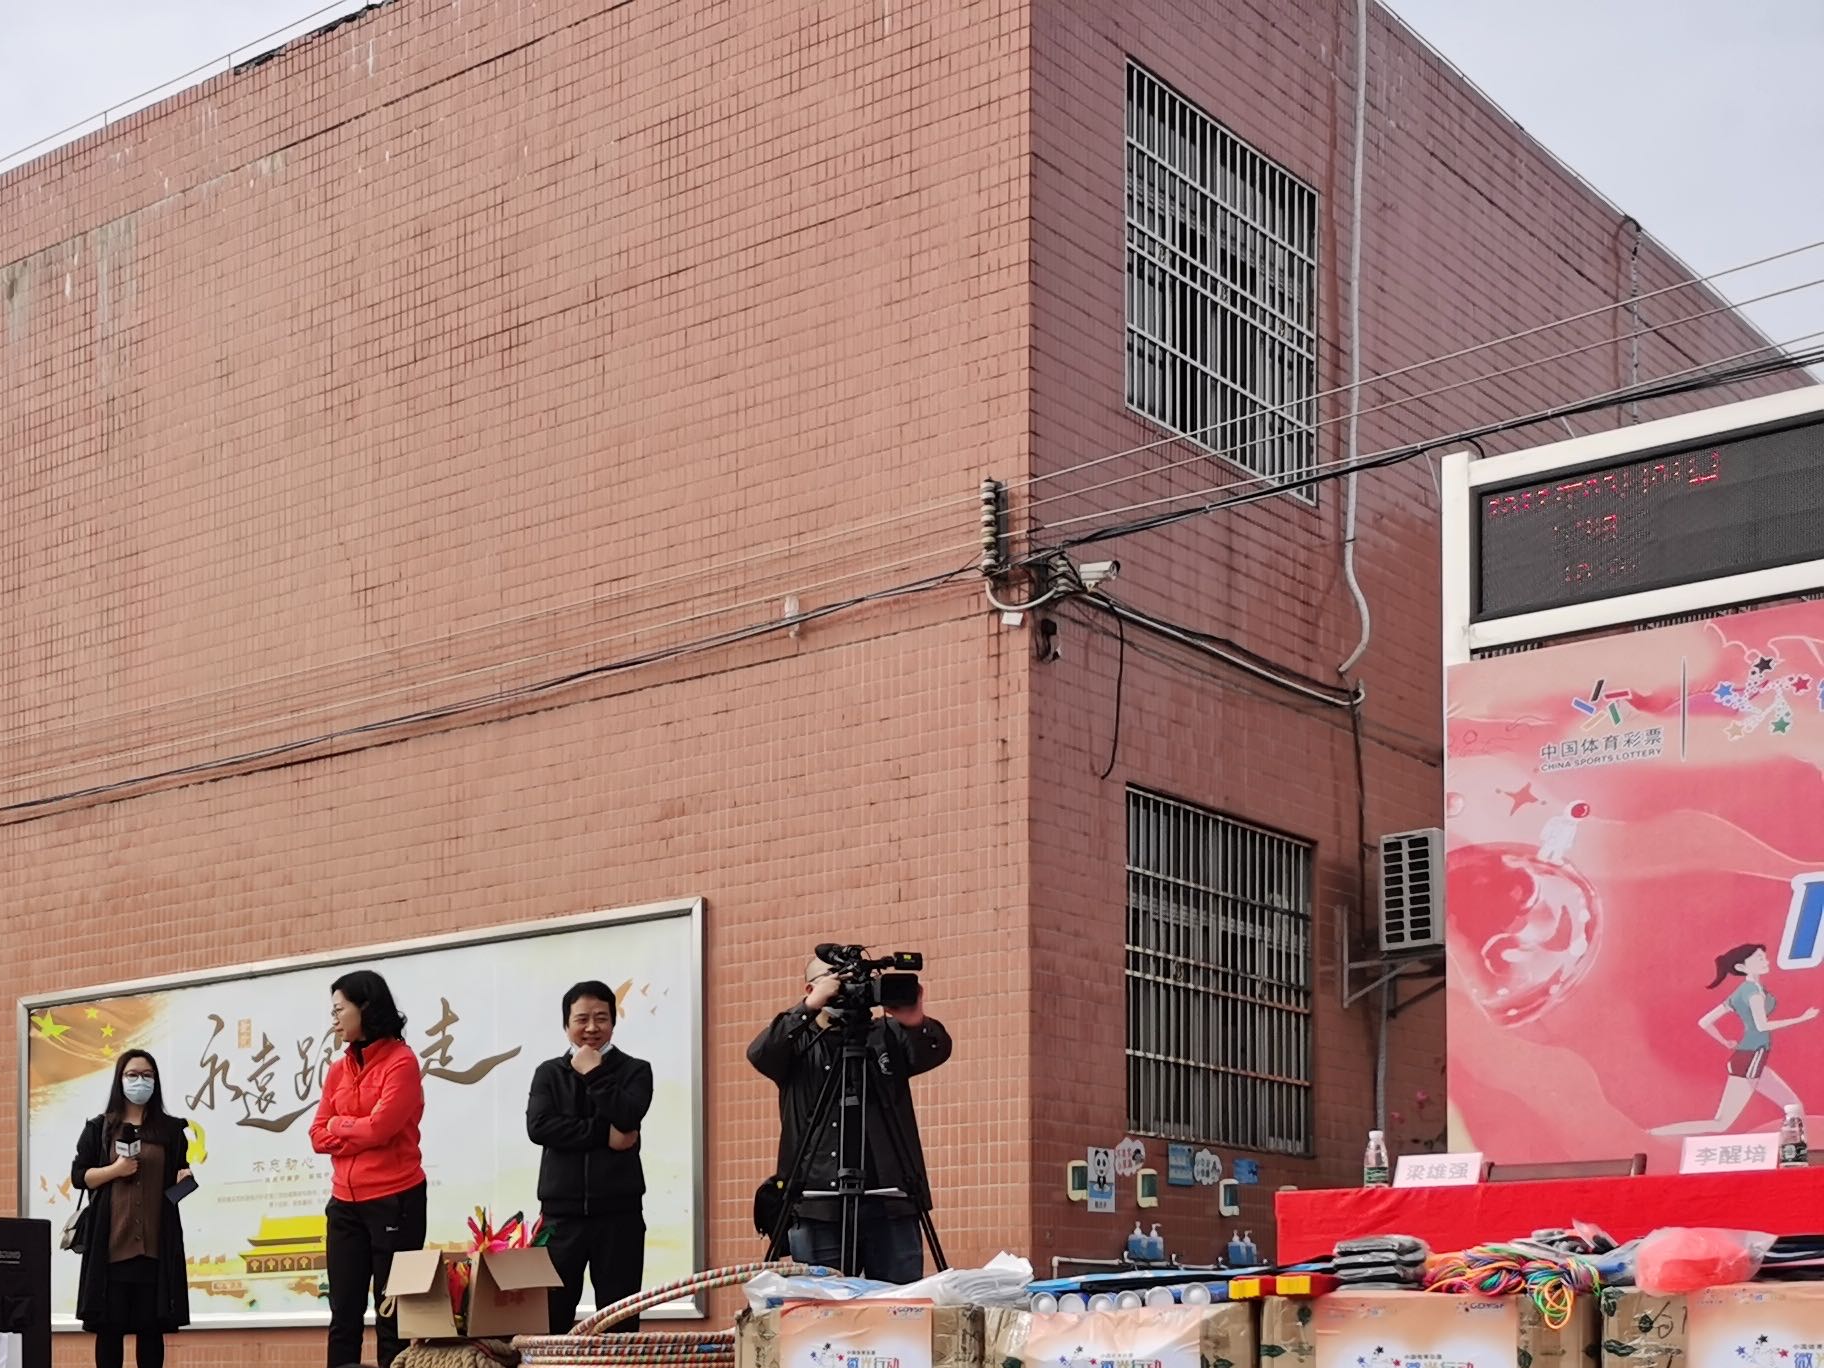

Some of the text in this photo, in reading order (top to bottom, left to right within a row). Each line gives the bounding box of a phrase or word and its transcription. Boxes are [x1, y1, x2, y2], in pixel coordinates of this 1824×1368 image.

[1541, 728, 1662, 760] 中国体育彩票
[1541, 748, 1662, 772] CHINA SPORTS LOTTERY
[1695, 1144, 1767, 1166] 李醒培
[1406, 1162, 1469, 1181] 梁雄强
